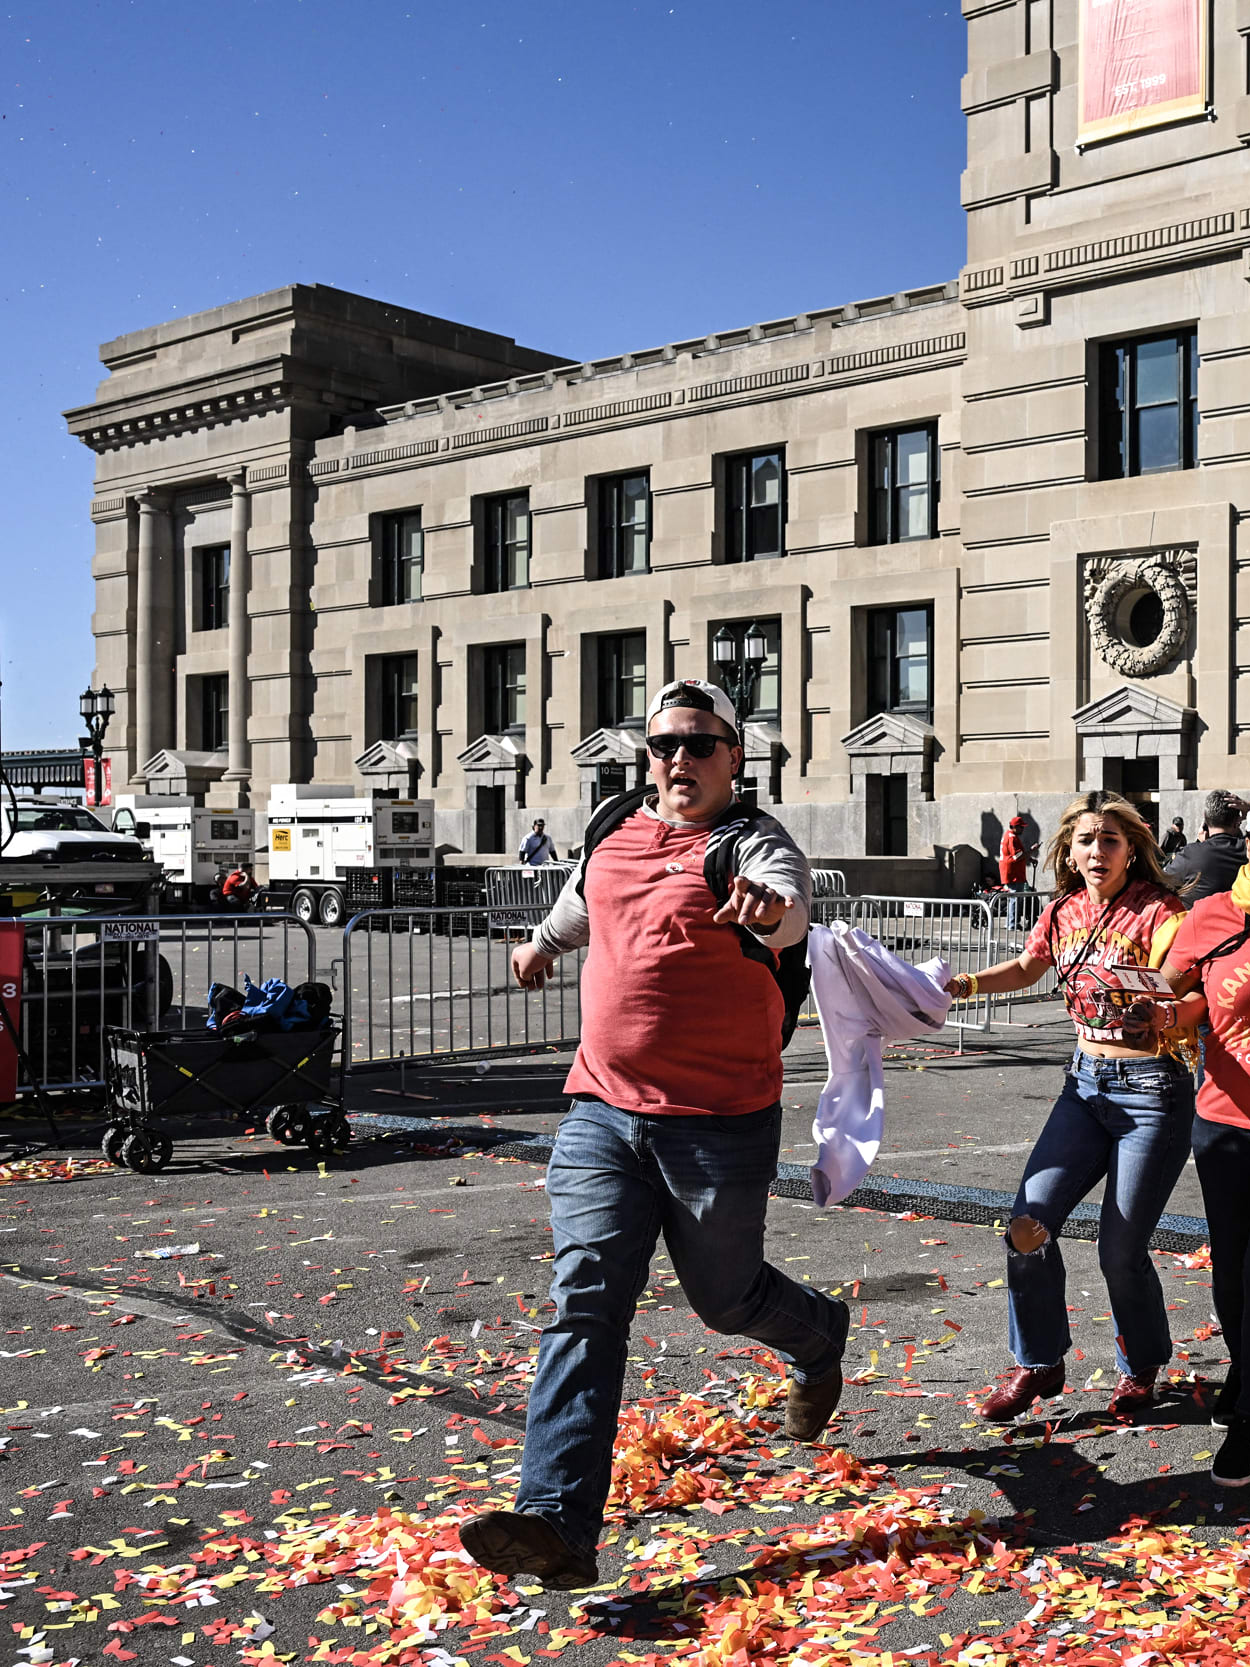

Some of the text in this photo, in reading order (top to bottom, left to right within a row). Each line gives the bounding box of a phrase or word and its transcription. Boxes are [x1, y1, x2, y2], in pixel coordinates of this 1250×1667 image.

[1115, 73, 1167, 96] EST. 1999
[601, 766, 610, 775] 10
[275, 833, 289, 841] Herc
[491, 911, 527, 920] NATIONAL
[104, 923, 158, 933] NATIONAL
